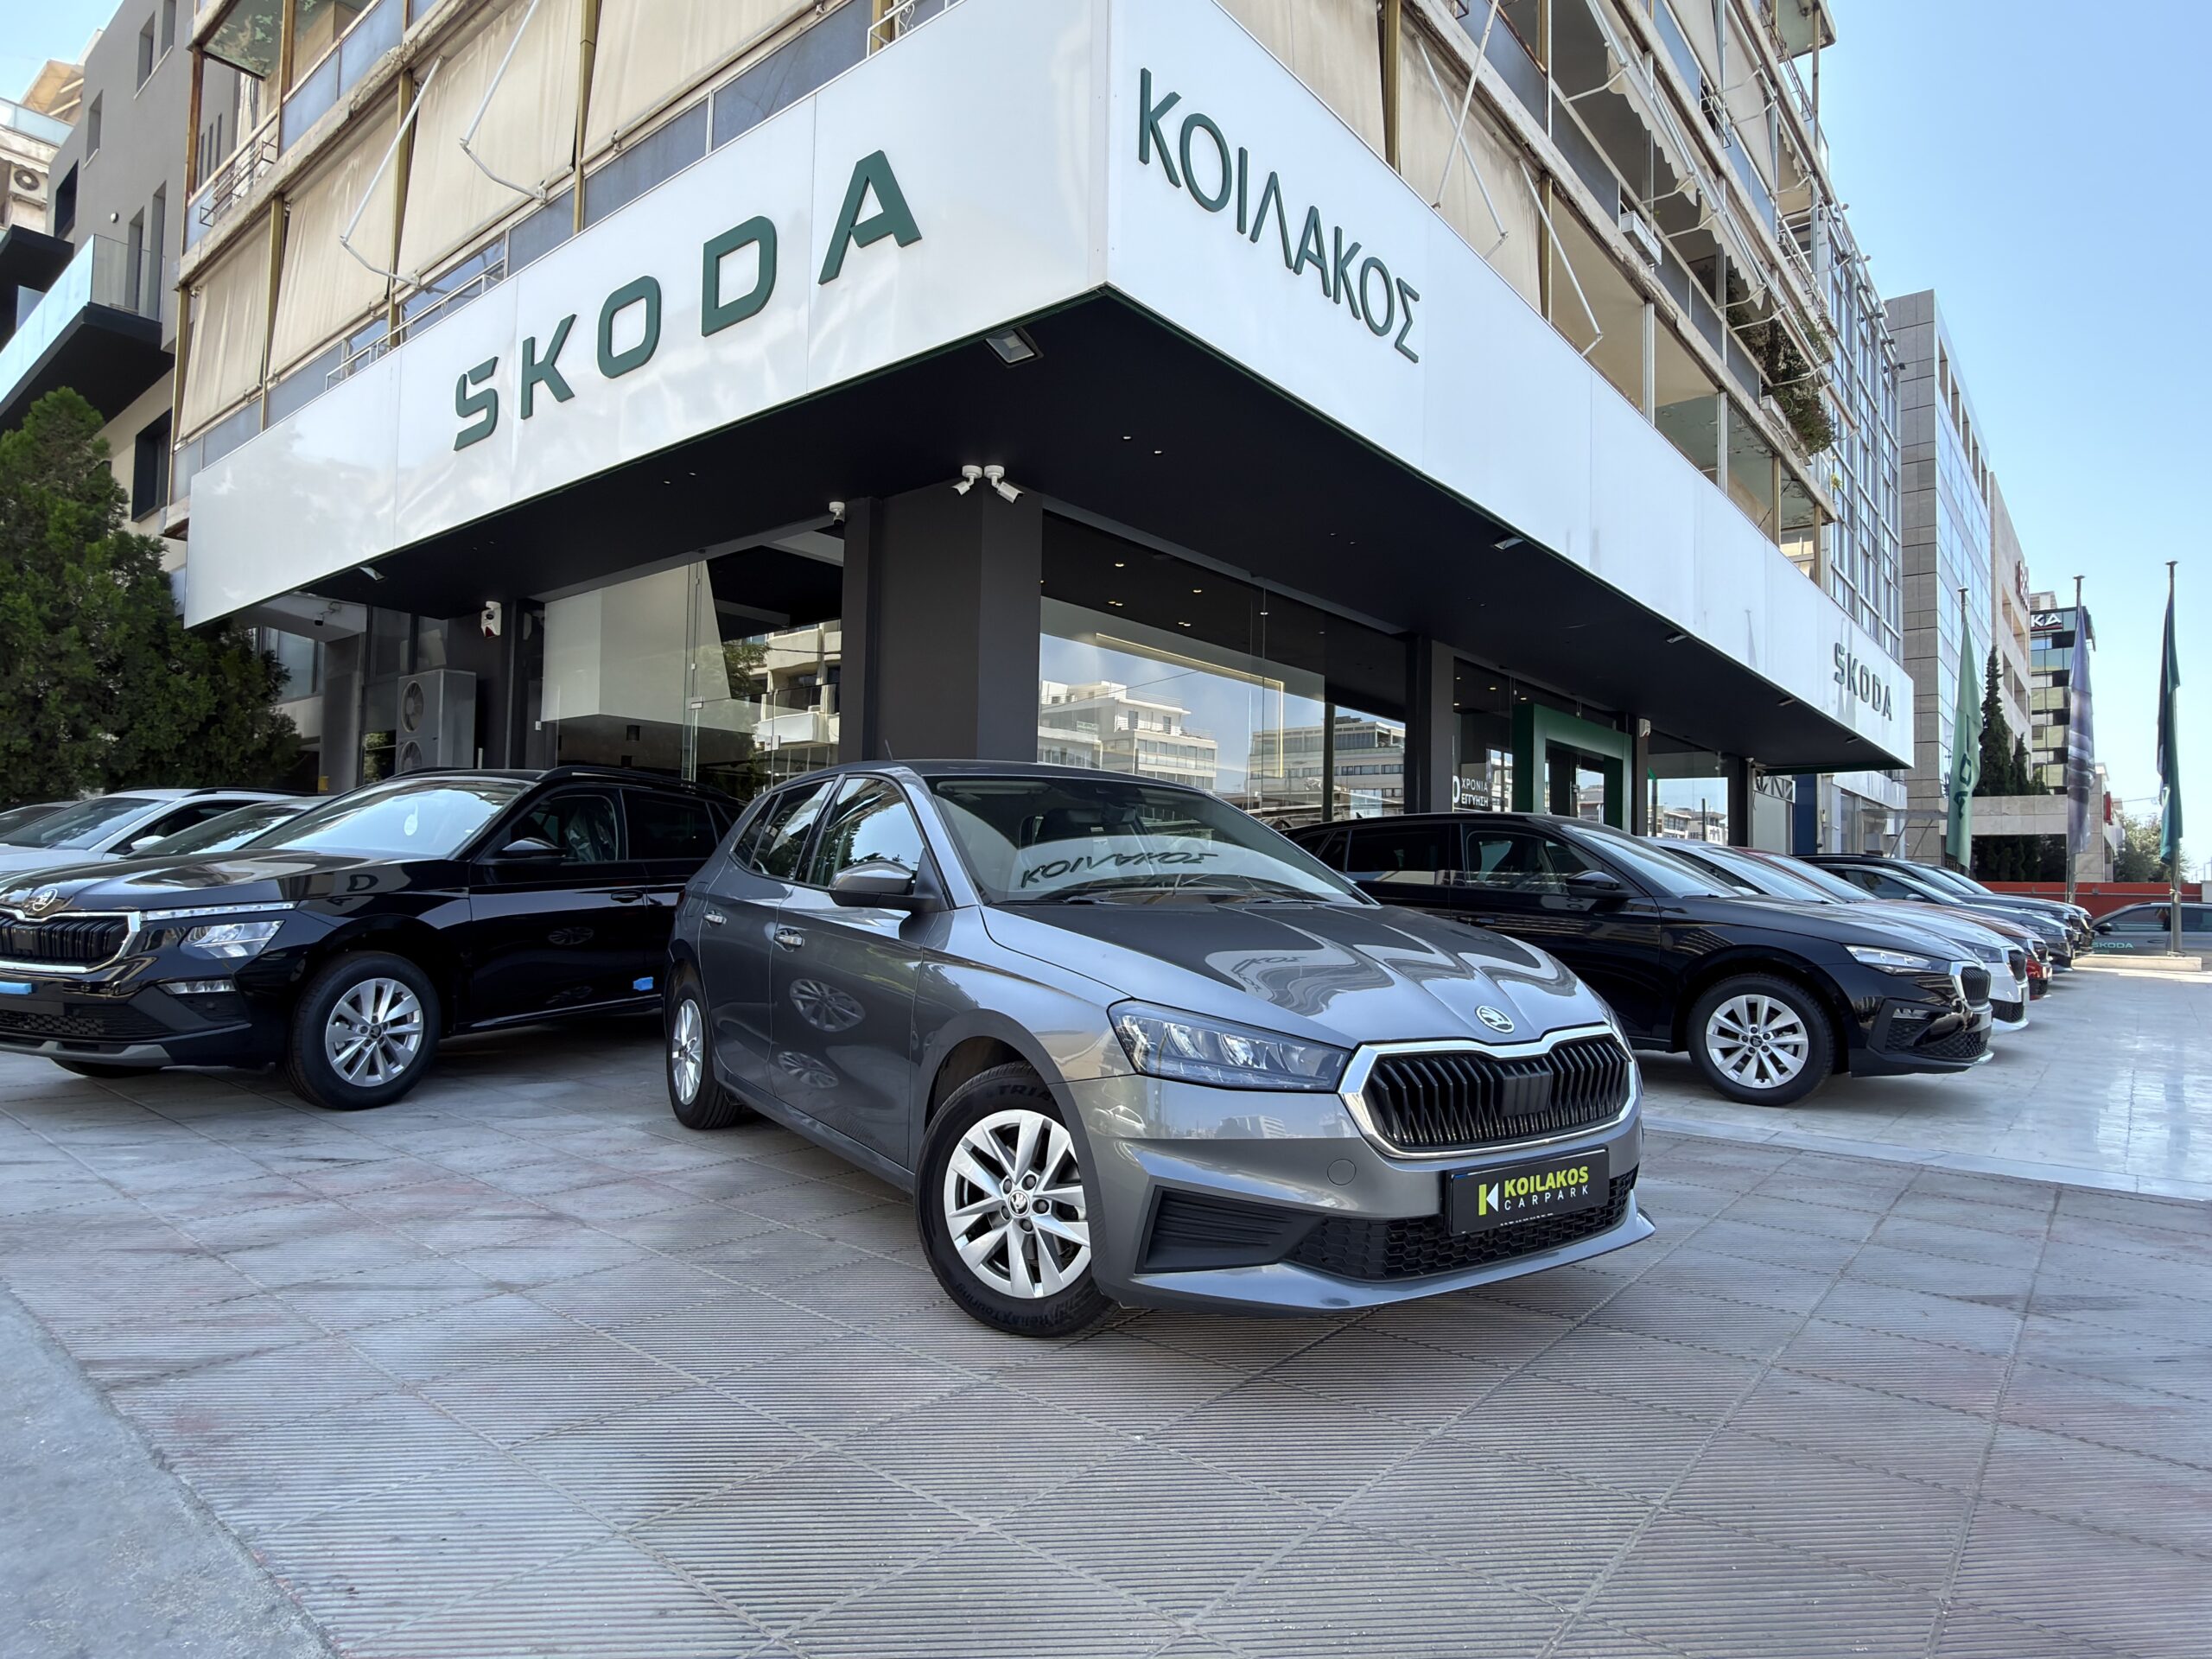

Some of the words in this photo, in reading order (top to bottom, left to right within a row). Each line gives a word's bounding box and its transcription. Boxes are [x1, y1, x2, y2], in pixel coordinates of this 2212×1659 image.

[1139, 68, 1420, 363] ΚΟΙΛΑΚΟΣ
[1461, 778, 1488, 792] ΧΡΟΝΙΑ
[1503, 1166, 1589, 1198] KOILAKOS
[1503, 1185, 1589, 1211] CARPARK
